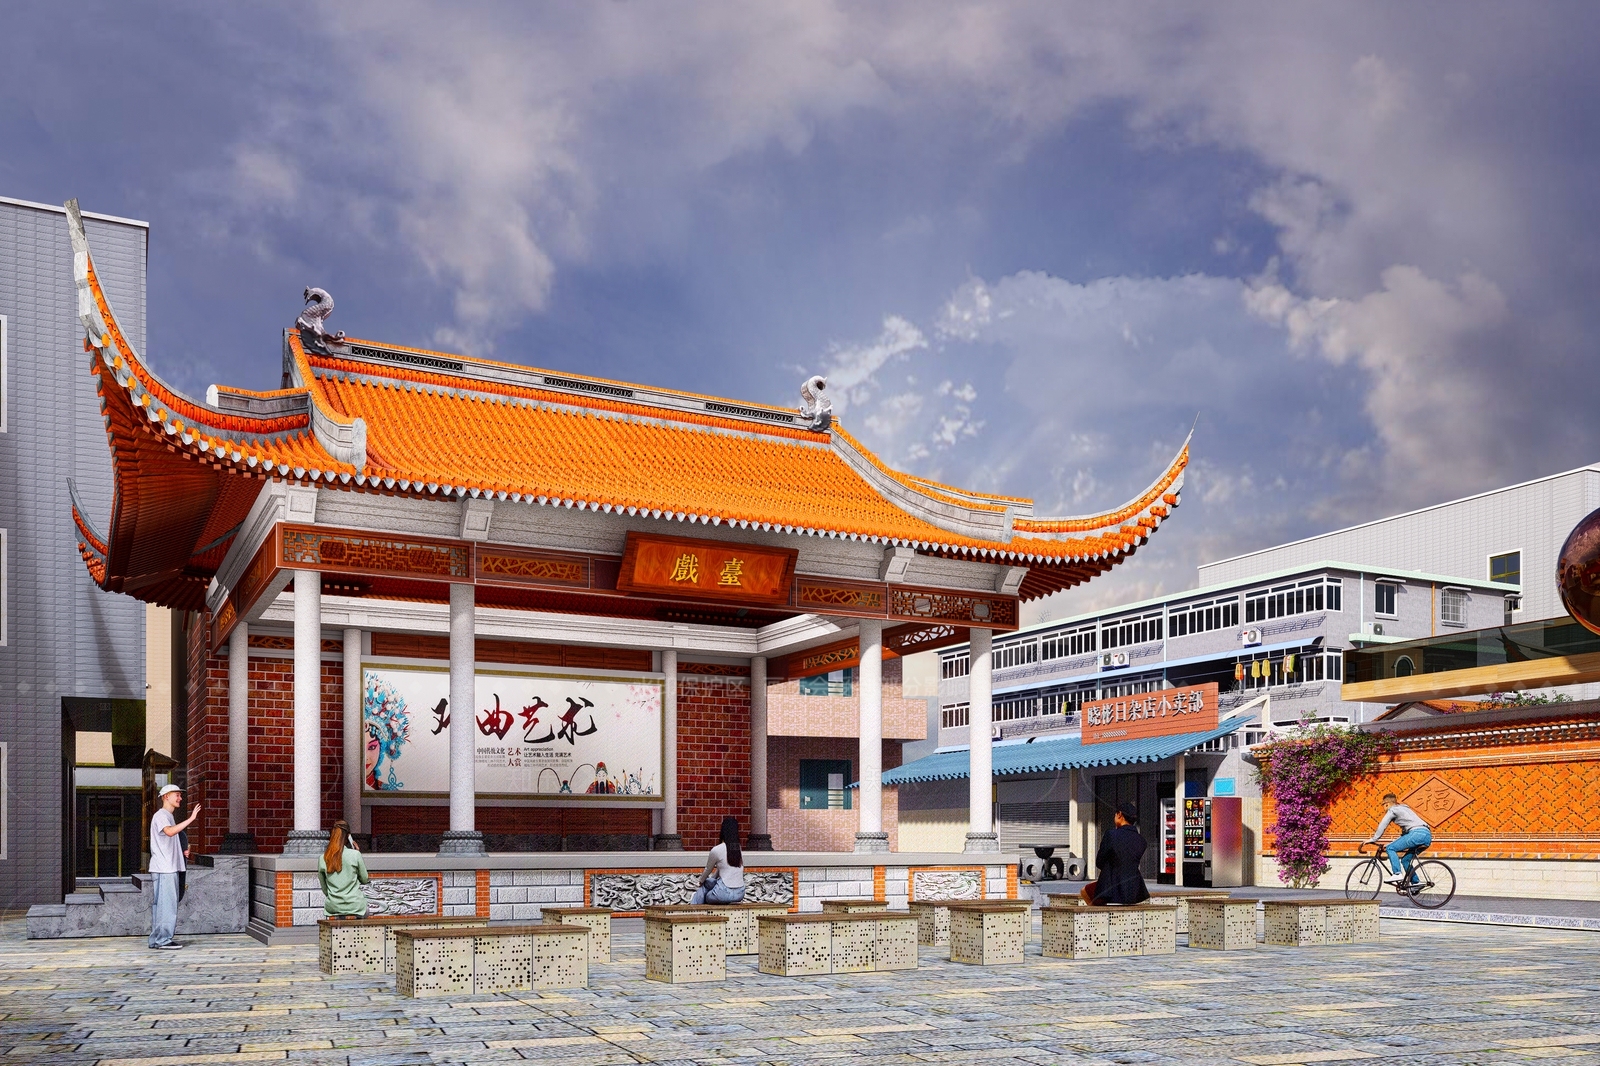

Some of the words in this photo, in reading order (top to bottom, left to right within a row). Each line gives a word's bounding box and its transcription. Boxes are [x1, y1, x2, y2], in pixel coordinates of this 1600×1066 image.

[669, 553, 744, 586] 戲臺
[1087, 690, 1204, 727] 晓彬日杂店小卖部
[1414, 784, 1456, 812] 福
